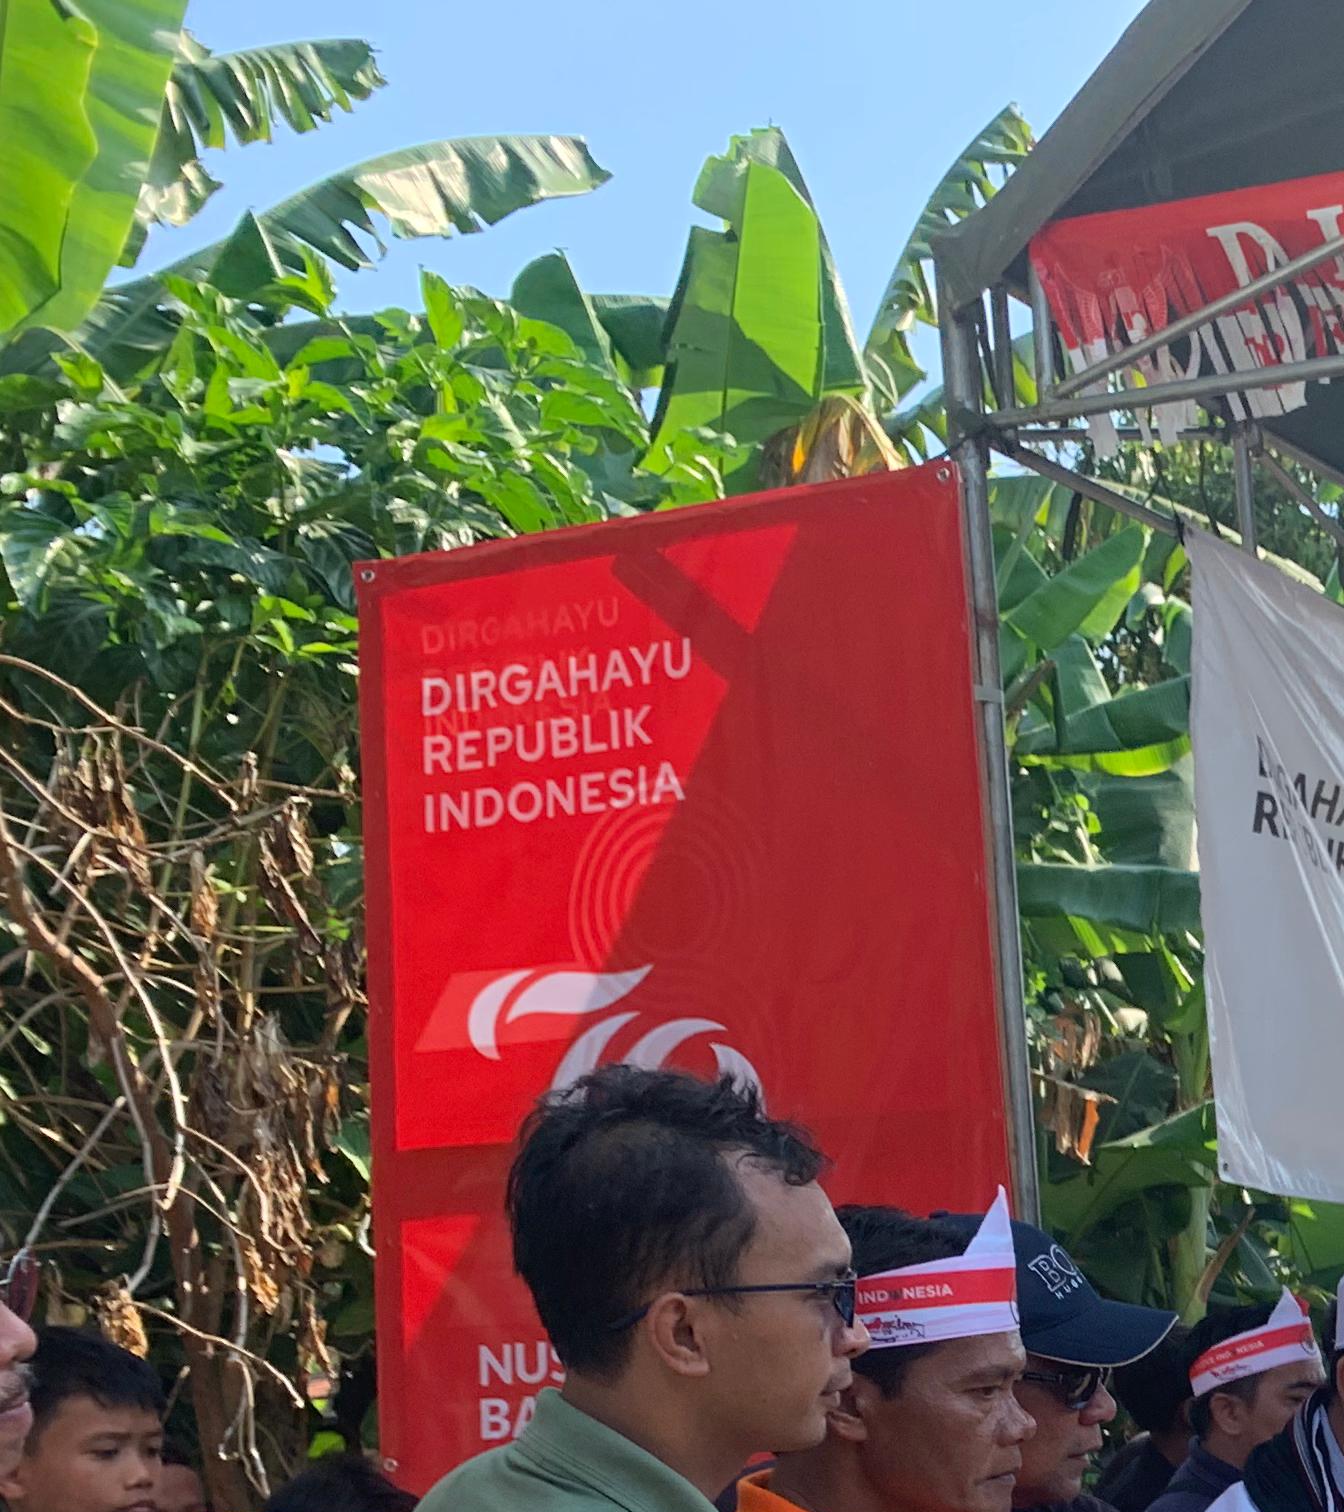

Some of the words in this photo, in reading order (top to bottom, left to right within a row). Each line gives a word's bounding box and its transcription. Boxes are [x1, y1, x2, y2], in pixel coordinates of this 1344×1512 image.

[421, 637, 692, 717] DIRGAHAYU
[422, 705, 653, 775] REPUBLIK
[424, 761, 686, 833] INDONESIA
